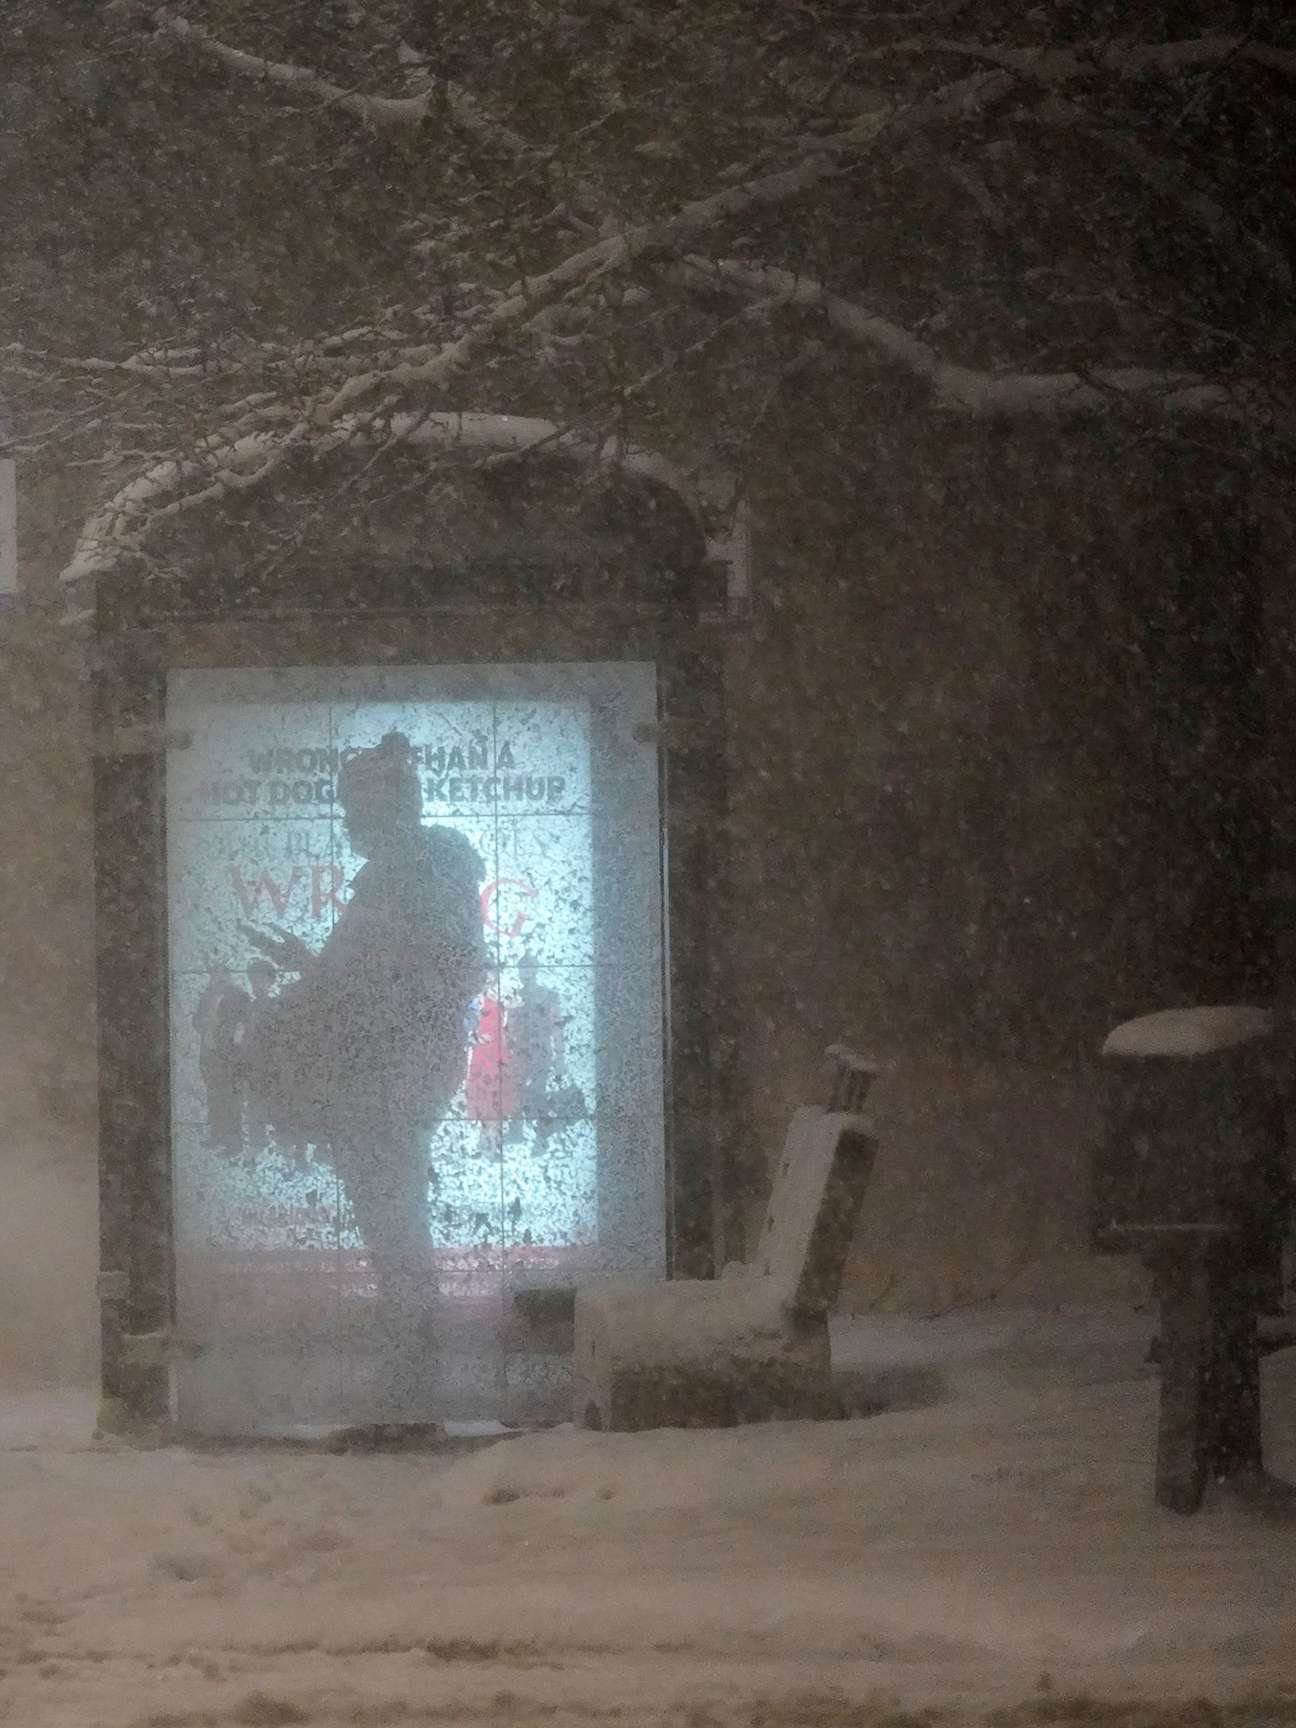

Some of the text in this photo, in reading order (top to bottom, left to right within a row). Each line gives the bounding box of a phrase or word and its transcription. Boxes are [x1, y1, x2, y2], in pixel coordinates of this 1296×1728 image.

[497, 741, 517, 770] A
[269, 778, 336, 804] DOG
[423, 775, 566, 803] KETCHUP
[229, 865, 539, 937] WRG
